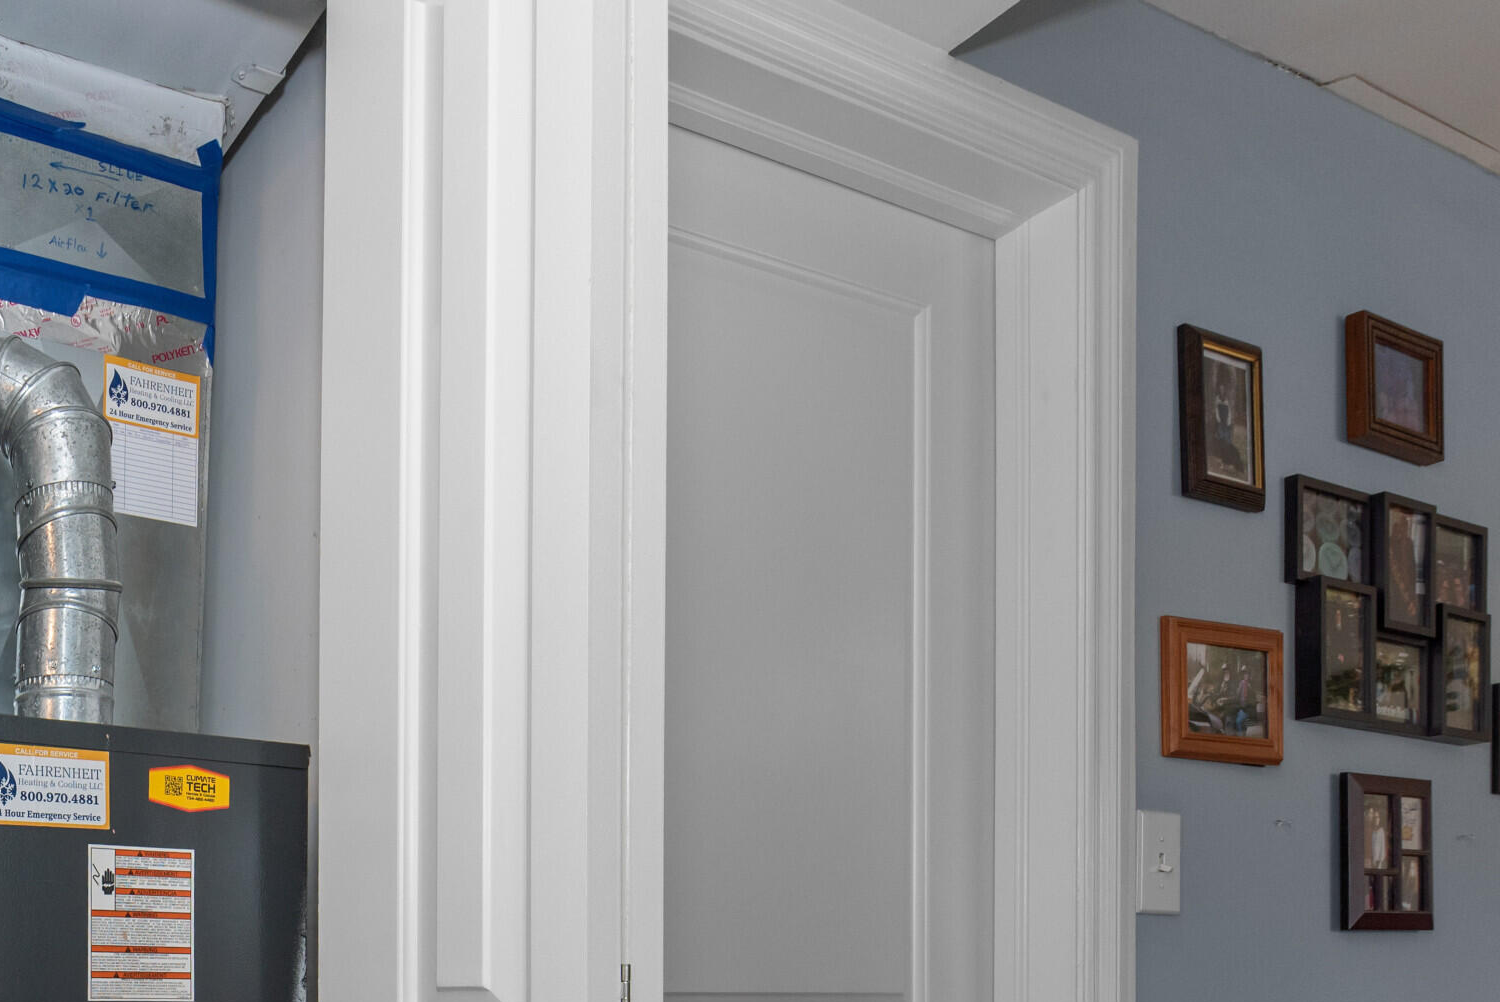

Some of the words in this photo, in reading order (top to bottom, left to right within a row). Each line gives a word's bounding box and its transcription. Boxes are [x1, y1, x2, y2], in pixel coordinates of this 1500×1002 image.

[130, 375, 194, 399] FAHRENHEIT
[130, 397, 191, 419] 800.970.4881
[109, 408, 117, 416] 24
[118, 410, 135, 420] Hour
[135, 413, 169, 428] Emergency
[170, 422, 192, 432] Service
[14, 747, 33, 755] CALL
[50, 750, 79, 759] SERVICE
[18, 763, 102, 780] FAHRENHEIT
[186, 774, 216, 784] CLIMATE
[18, 777, 48, 788] Heating
[58, 779, 87, 791] Cooling
[88, 782, 103, 790] LLC
[186, 782, 216, 793] TECH
[20, 790, 100, 806] 800.970.4881
[4, 809, 25, 818] Hour
[27, 810, 71, 822] Emergency
[73, 812, 101, 822] Service
